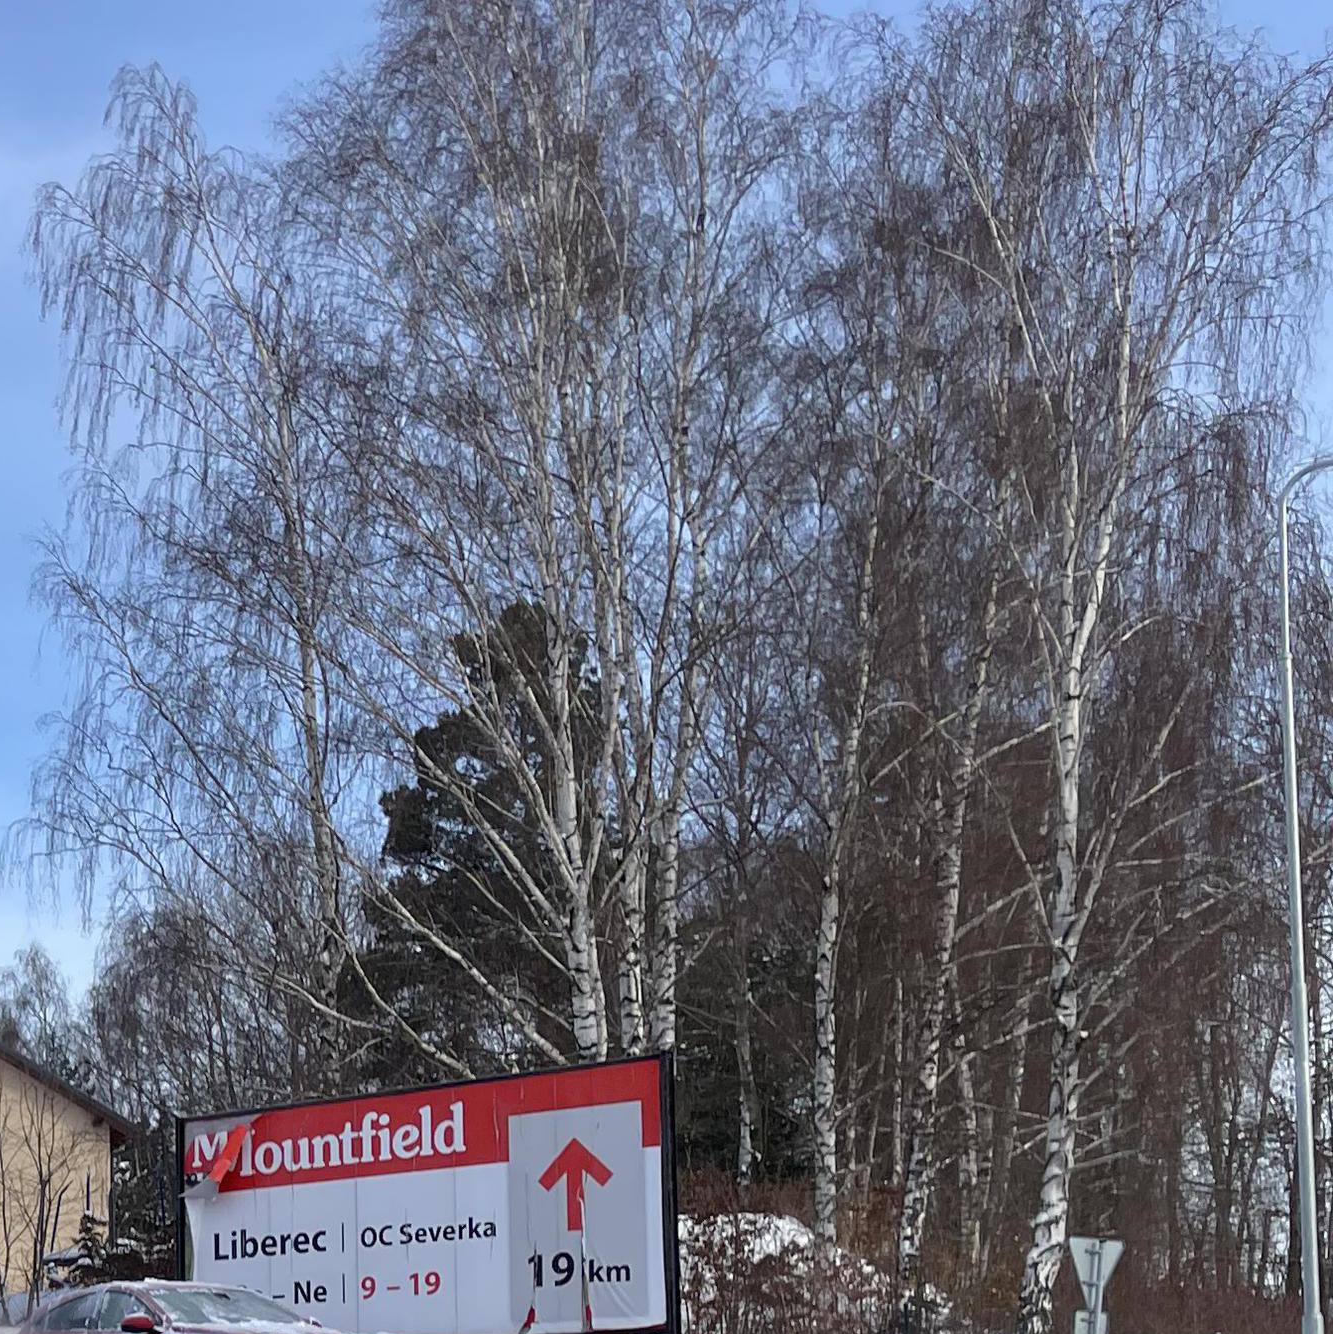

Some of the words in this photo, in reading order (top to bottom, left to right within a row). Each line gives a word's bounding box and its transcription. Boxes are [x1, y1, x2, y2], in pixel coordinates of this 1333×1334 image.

[192, 1102, 466, 1177] Mountfield
[213, 1226, 327, 1261] Liberec
[360, 1225, 393, 1248] OC
[399, 1217, 497, 1245] Severka
[293, 1280, 327, 1304] Ne
[361, 1275, 376, 1300] 9
[409, 1271, 441, 1296] 19
[528, 1252, 575, 1287] 19
[588, 1259, 631, 1282] km
